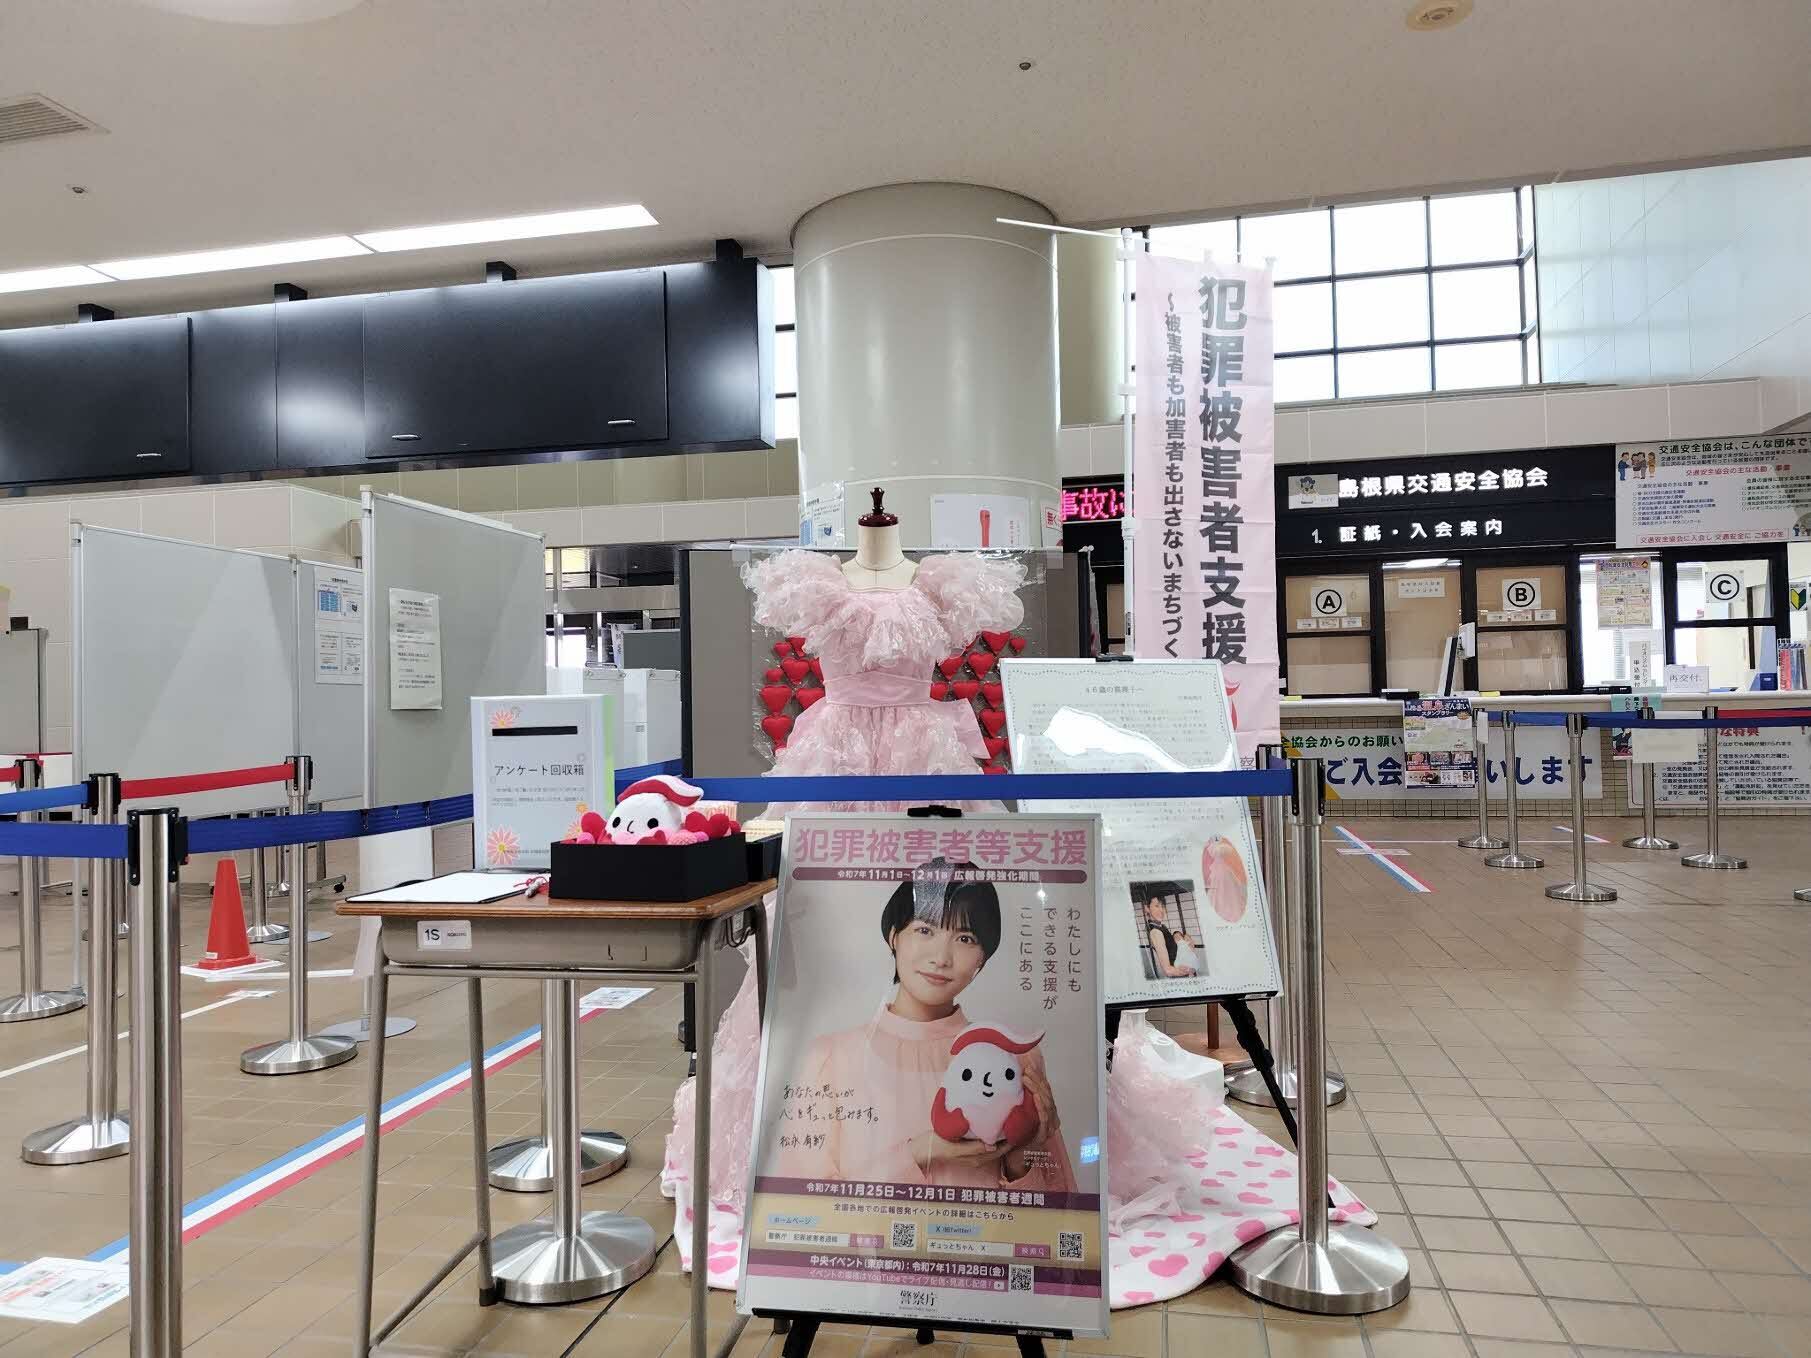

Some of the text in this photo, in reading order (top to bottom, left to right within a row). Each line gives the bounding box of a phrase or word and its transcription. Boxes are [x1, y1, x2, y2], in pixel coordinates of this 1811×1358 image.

[1198, 275, 1248, 665] 犯罪被害者支援
[1338, 466, 1549, 499] 島根県交通安全協会
[1339, 519, 1503, 543] 証紙・入会案内
[1515, 587, 1528, 601] B
[1717, 579, 1732, 595] C
[1322, 595, 1336, 609] A
[494, 764, 584, 776] アンケート回収箱
[796, 827, 1088, 865] 犯罪被害者等支援
[1019, 907, 1033, 992] ここにある
[1043, 906, 1057, 1011] できる支援が
[1067, 907, 1082, 993] わたしにも
[961, 1189, 1046, 1206] 犯罪被害者週間
[900, 1289, 938, 1306] 警察庁
